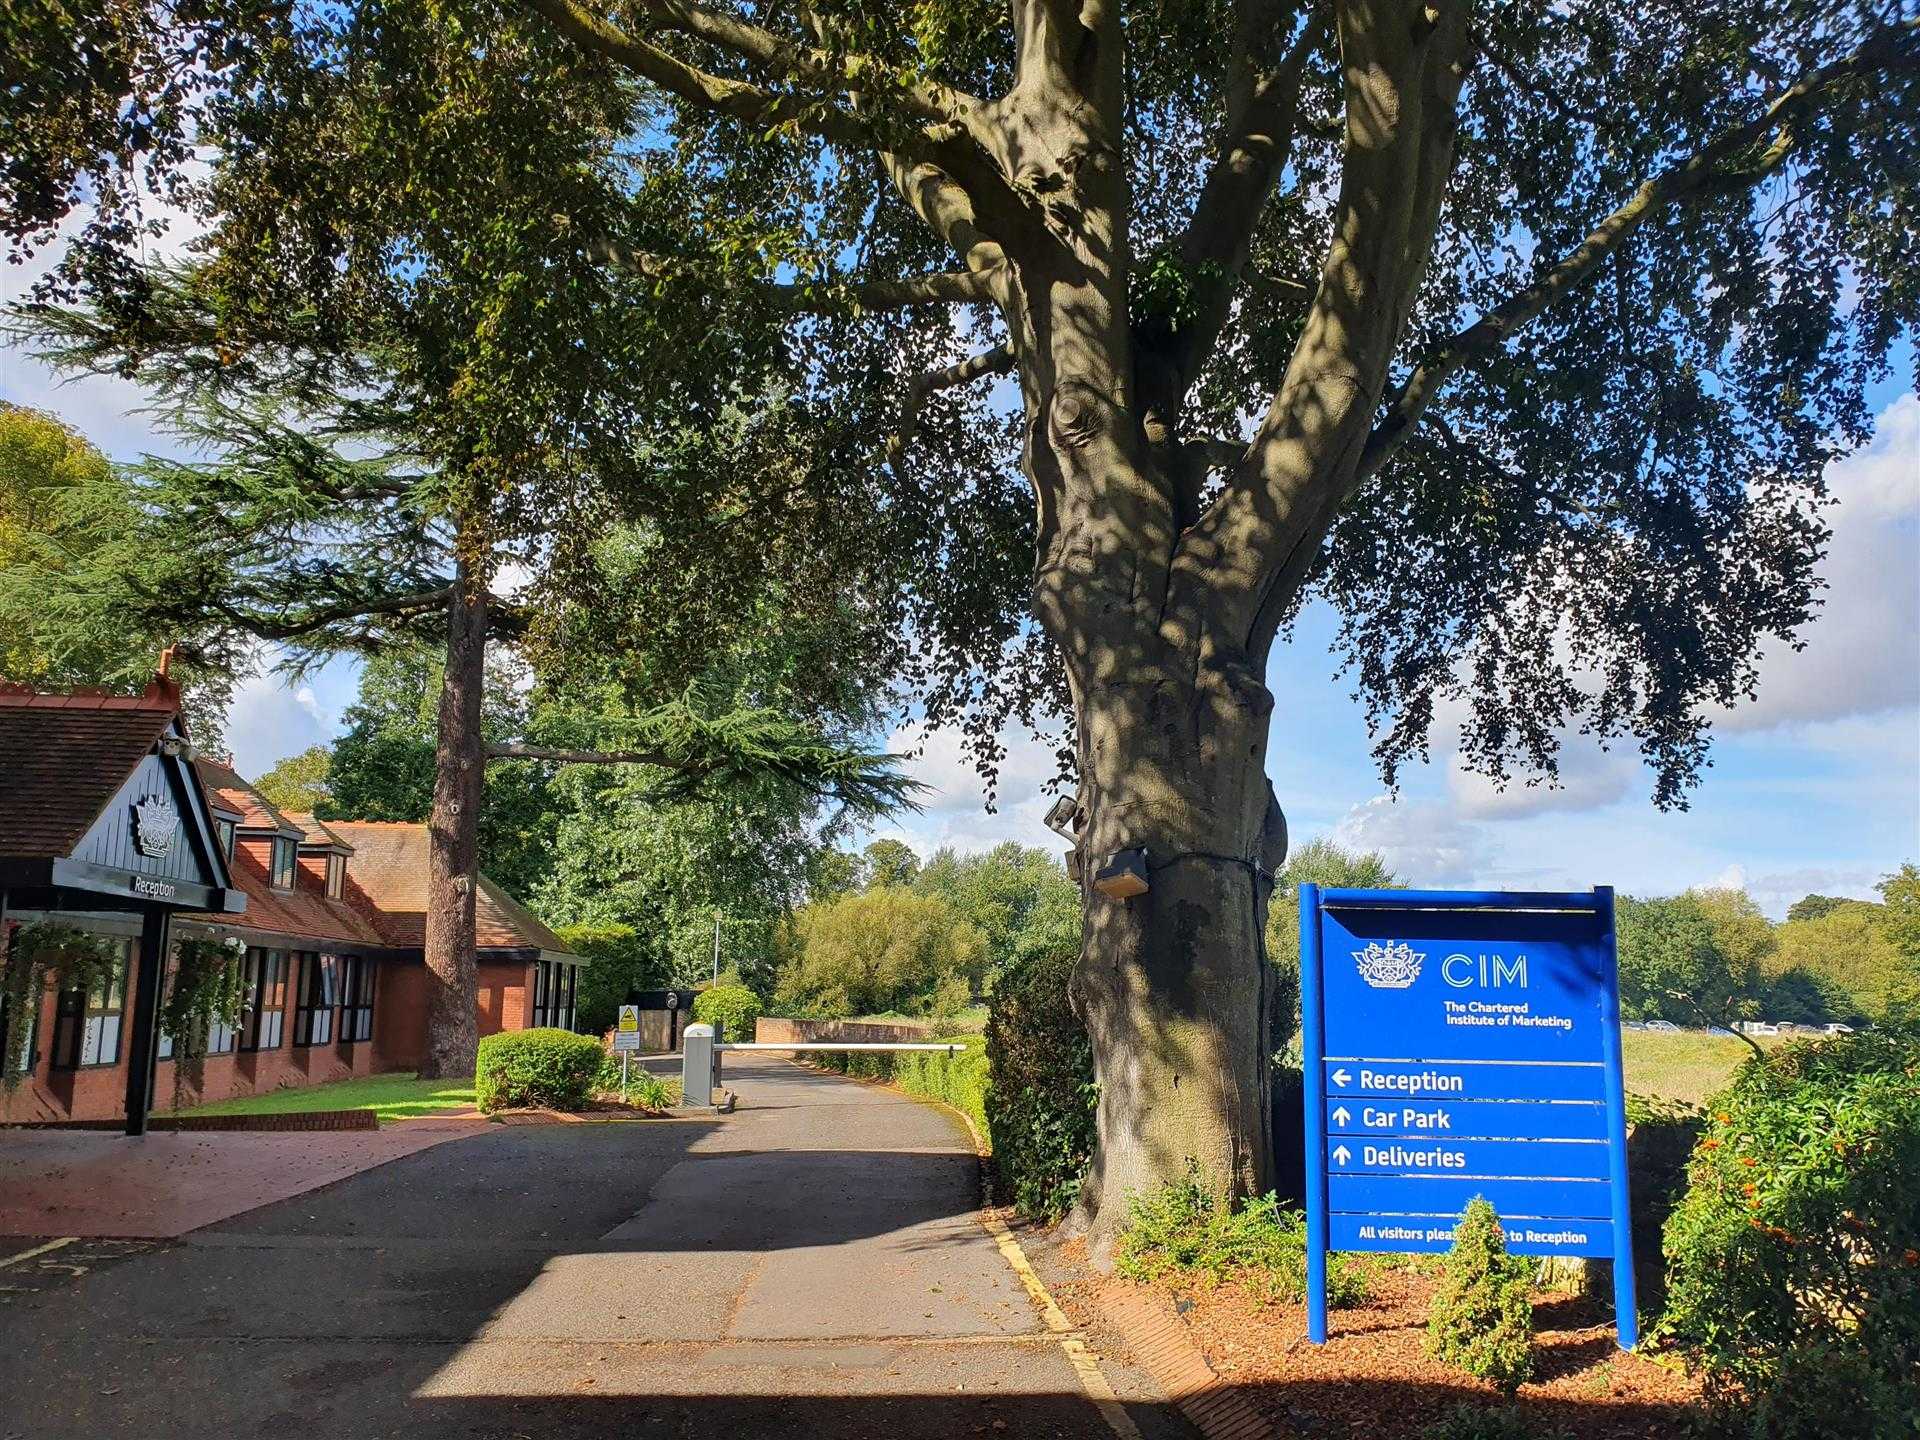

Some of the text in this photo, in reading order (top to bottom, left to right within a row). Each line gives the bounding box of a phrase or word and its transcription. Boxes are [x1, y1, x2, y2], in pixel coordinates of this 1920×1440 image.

[134, 876, 175, 899] Reception
[1441, 953, 1528, 989] CIM
[1444, 1001, 1529, 1014] The Chartered
[1446, 1014, 1572, 1030] Institute of Marketing
[1360, 1070, 1463, 1094] Reception
[1363, 1108, 1451, 1129] Car Park
[1364, 1146, 1466, 1168] Deliveries
[1359, 1226, 1376, 1239] All
[1378, 1226, 1424, 1240] visitors
[1510, 1230, 1524, 1242] to
[1526, 1230, 1587, 1246] Reception
